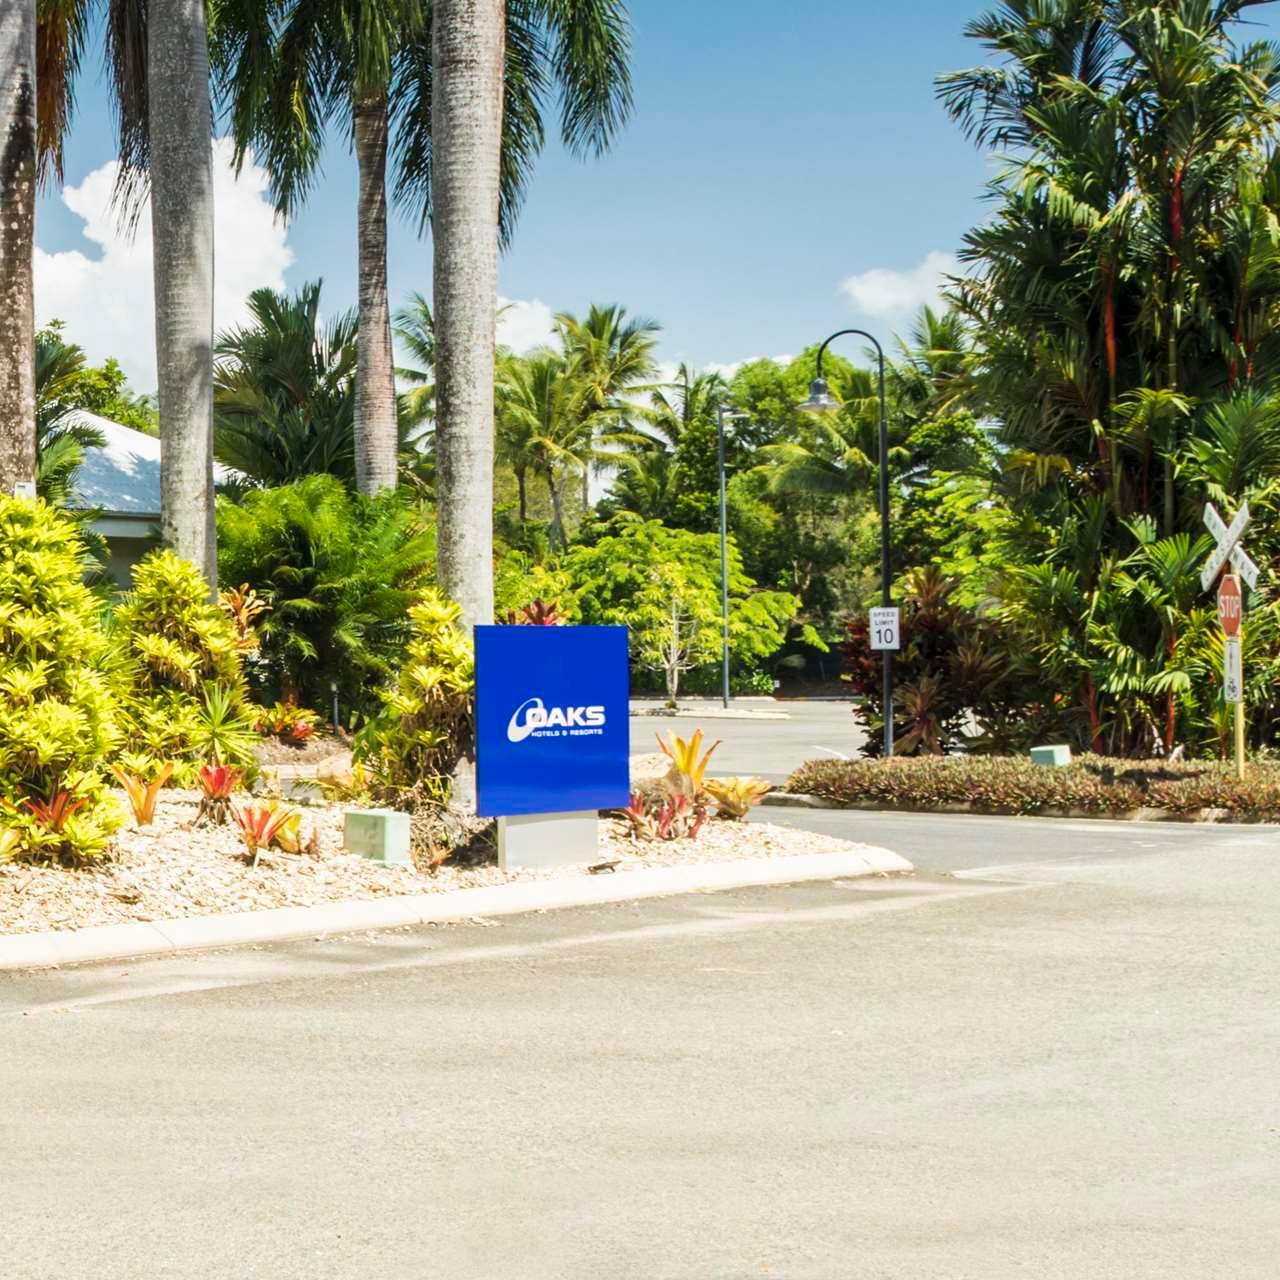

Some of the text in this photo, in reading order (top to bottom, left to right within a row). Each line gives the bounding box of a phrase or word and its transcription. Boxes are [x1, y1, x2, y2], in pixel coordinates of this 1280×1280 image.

[1220, 595, 1239, 618] STOP
[875, 628, 894, 644] 10
[525, 706, 605, 728] OAKS
[569, 728, 603, 736] RESORTS
